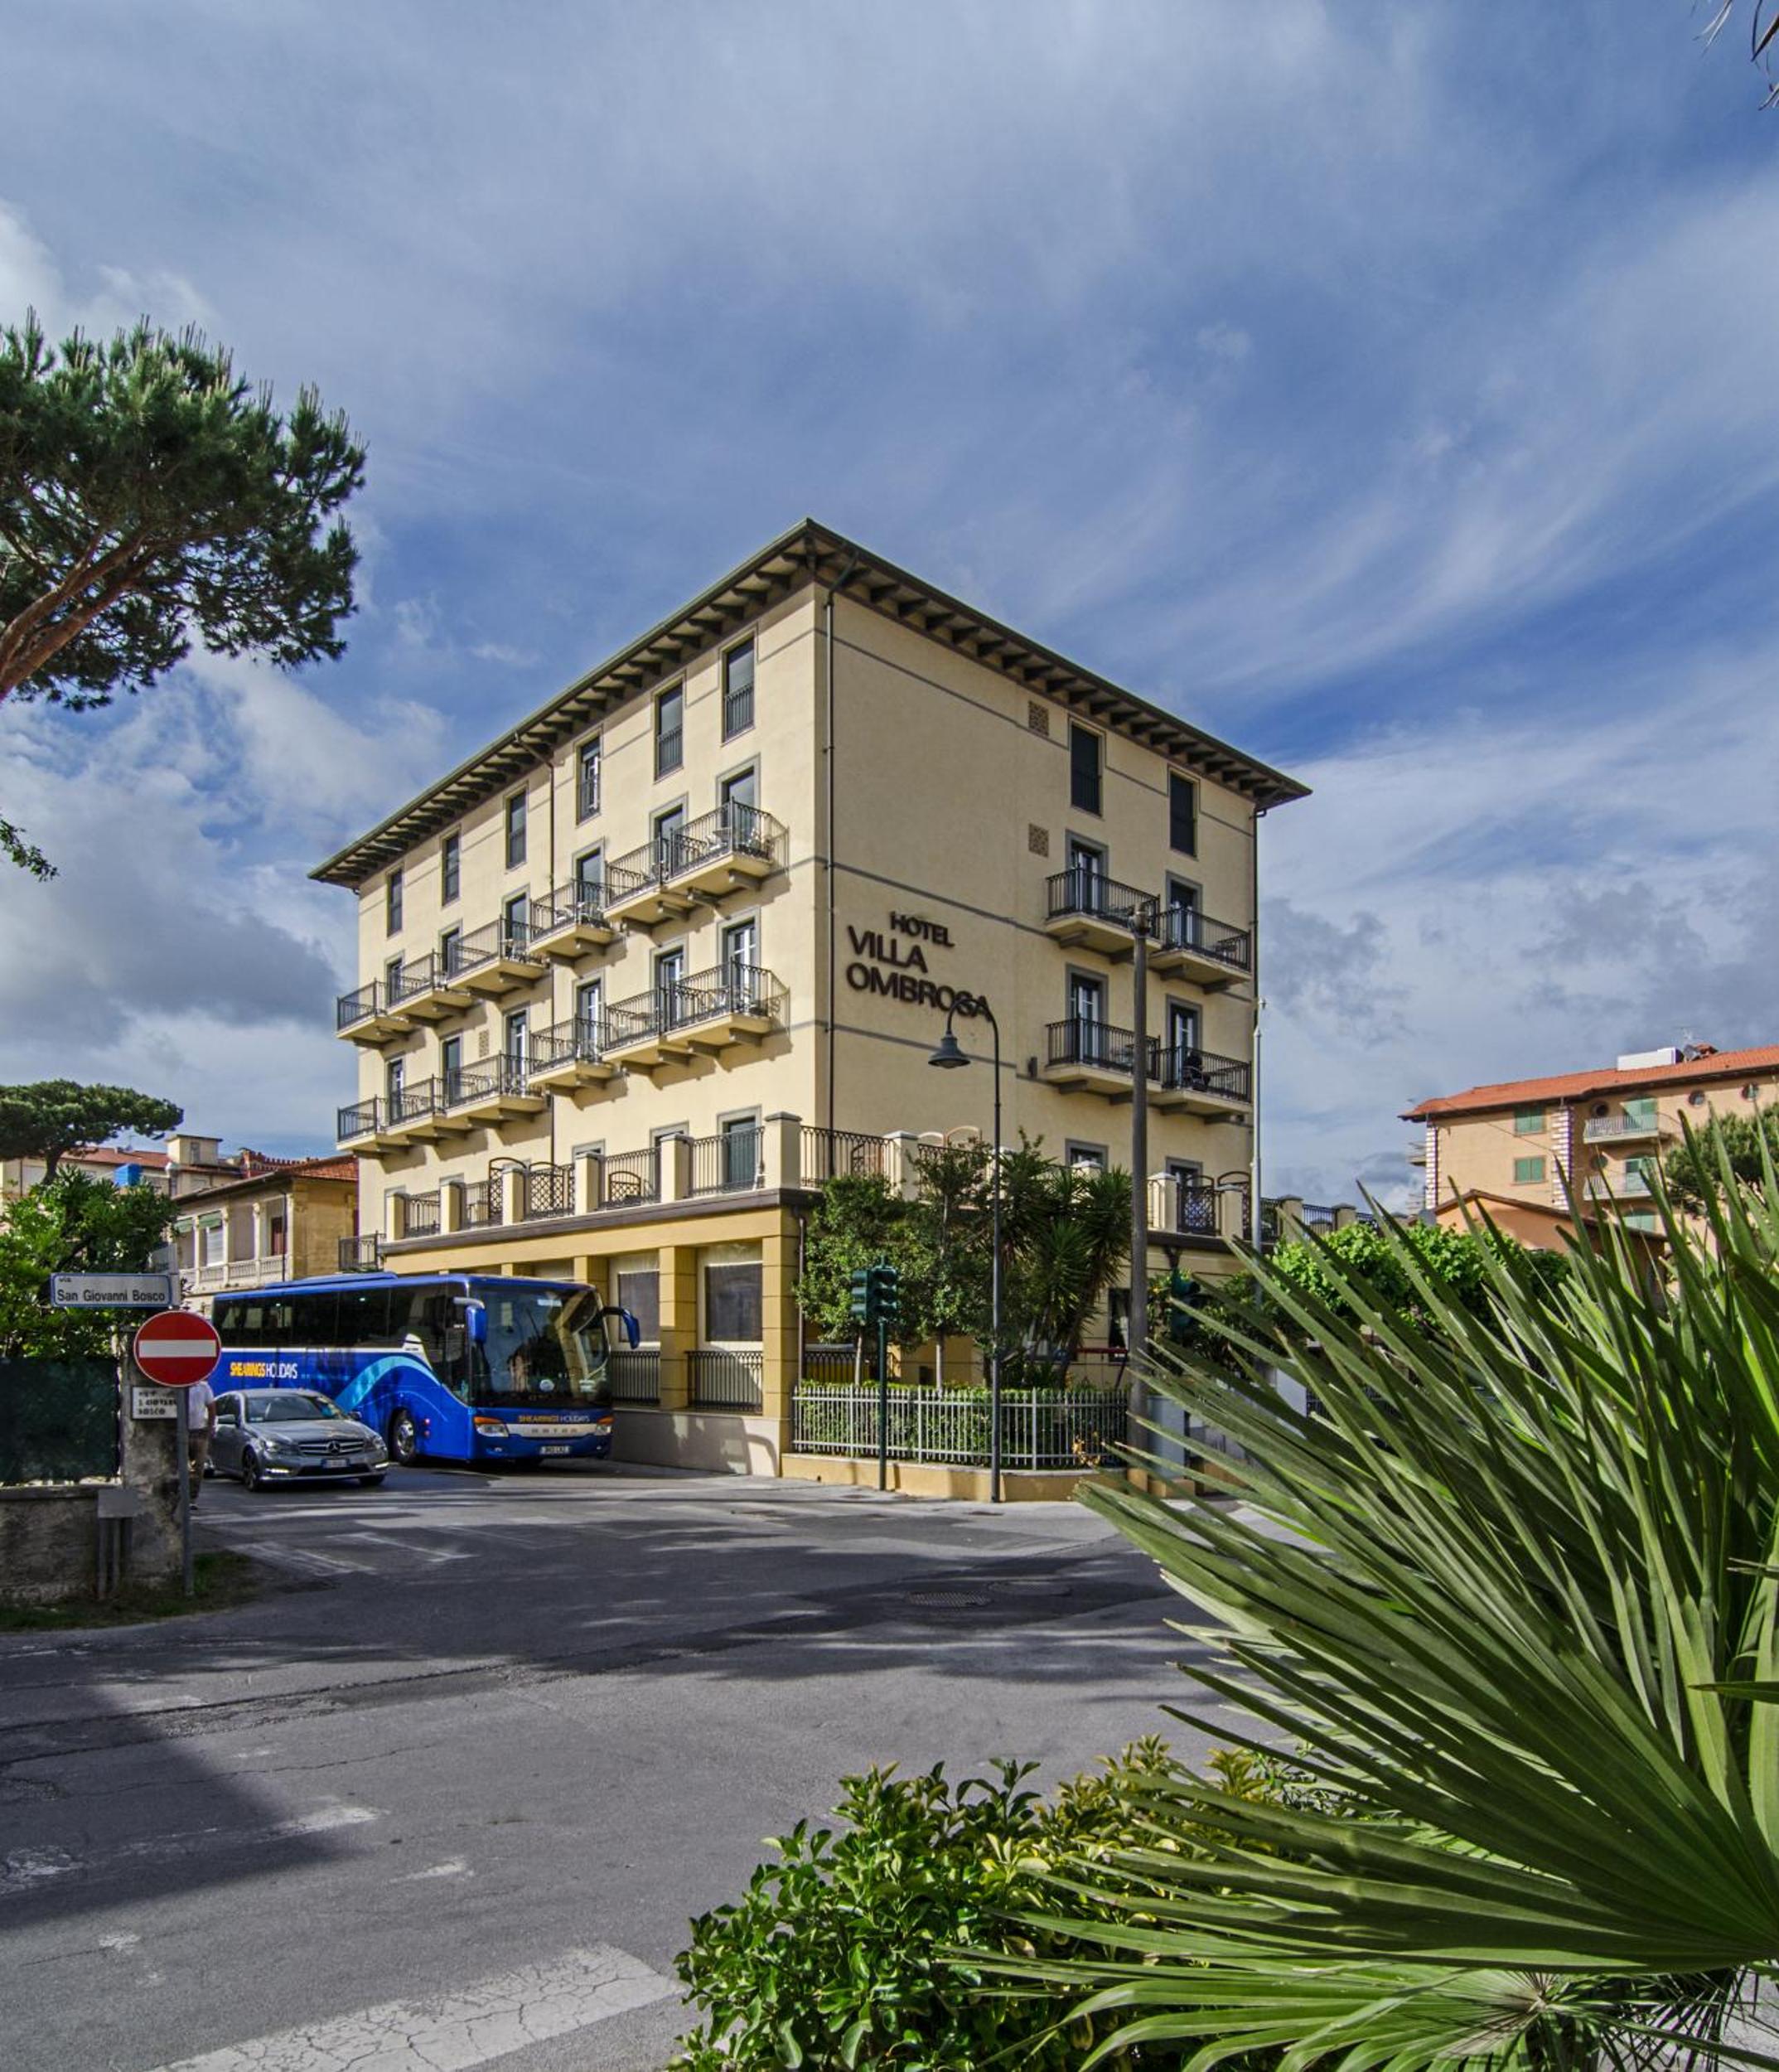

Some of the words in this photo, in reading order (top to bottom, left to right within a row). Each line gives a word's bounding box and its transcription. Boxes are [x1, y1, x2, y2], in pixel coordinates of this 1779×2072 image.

[848, 925, 928, 974] VILLA
[889, 911, 955, 948] HOTEL
[846, 962, 993, 1023] OMBROSA
[57, 1289, 78, 1302] San
[84, 1289, 128, 1302] Giovanni
[133, 1290, 166, 1302] Bosco
